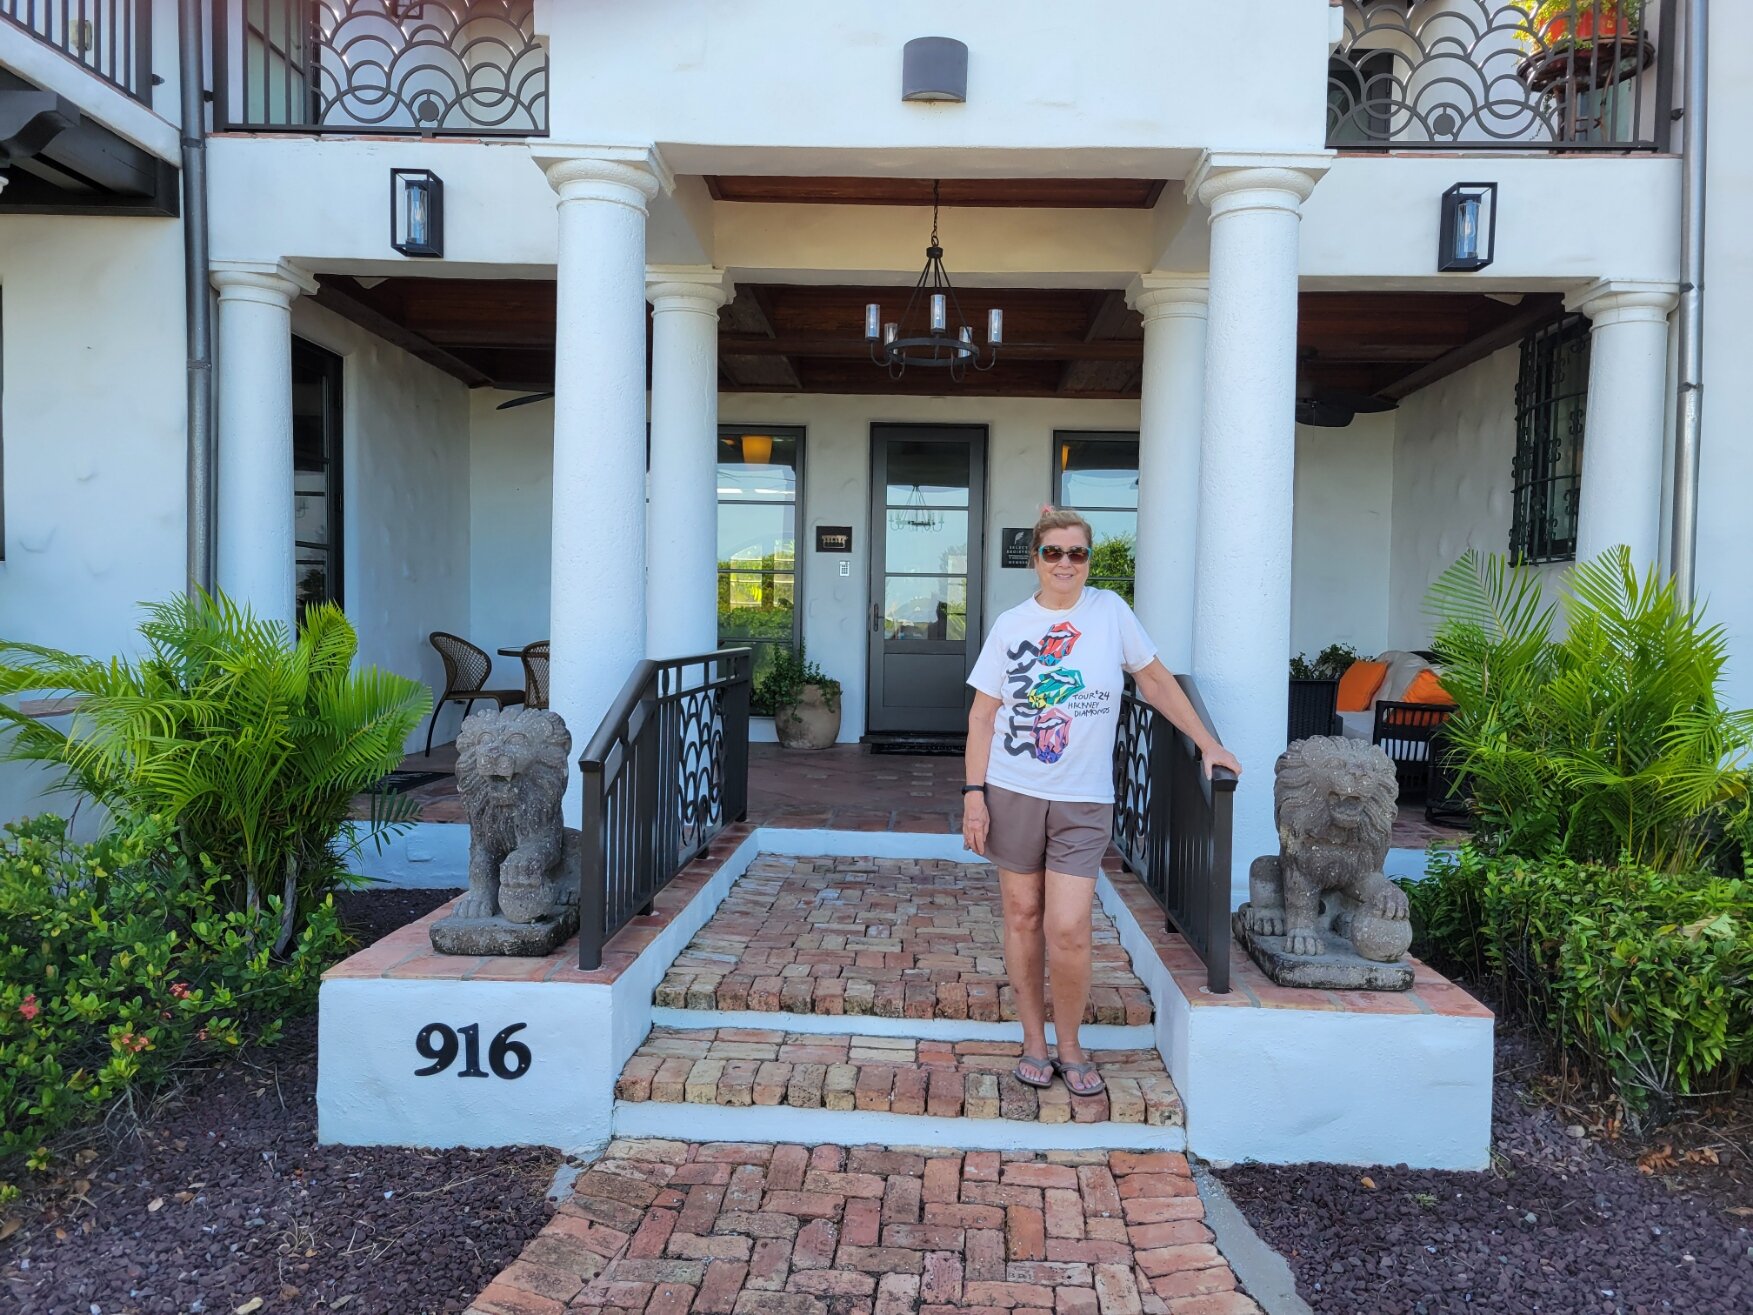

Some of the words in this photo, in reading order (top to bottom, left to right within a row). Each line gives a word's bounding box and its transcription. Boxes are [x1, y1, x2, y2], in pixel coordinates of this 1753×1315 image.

[1004, 640, 1041, 759] STONES
[1068, 701, 1100, 709] HACKNEY
[1074, 707, 1110, 717] DIAMONDS
[414, 1022, 532, 1080] 916
